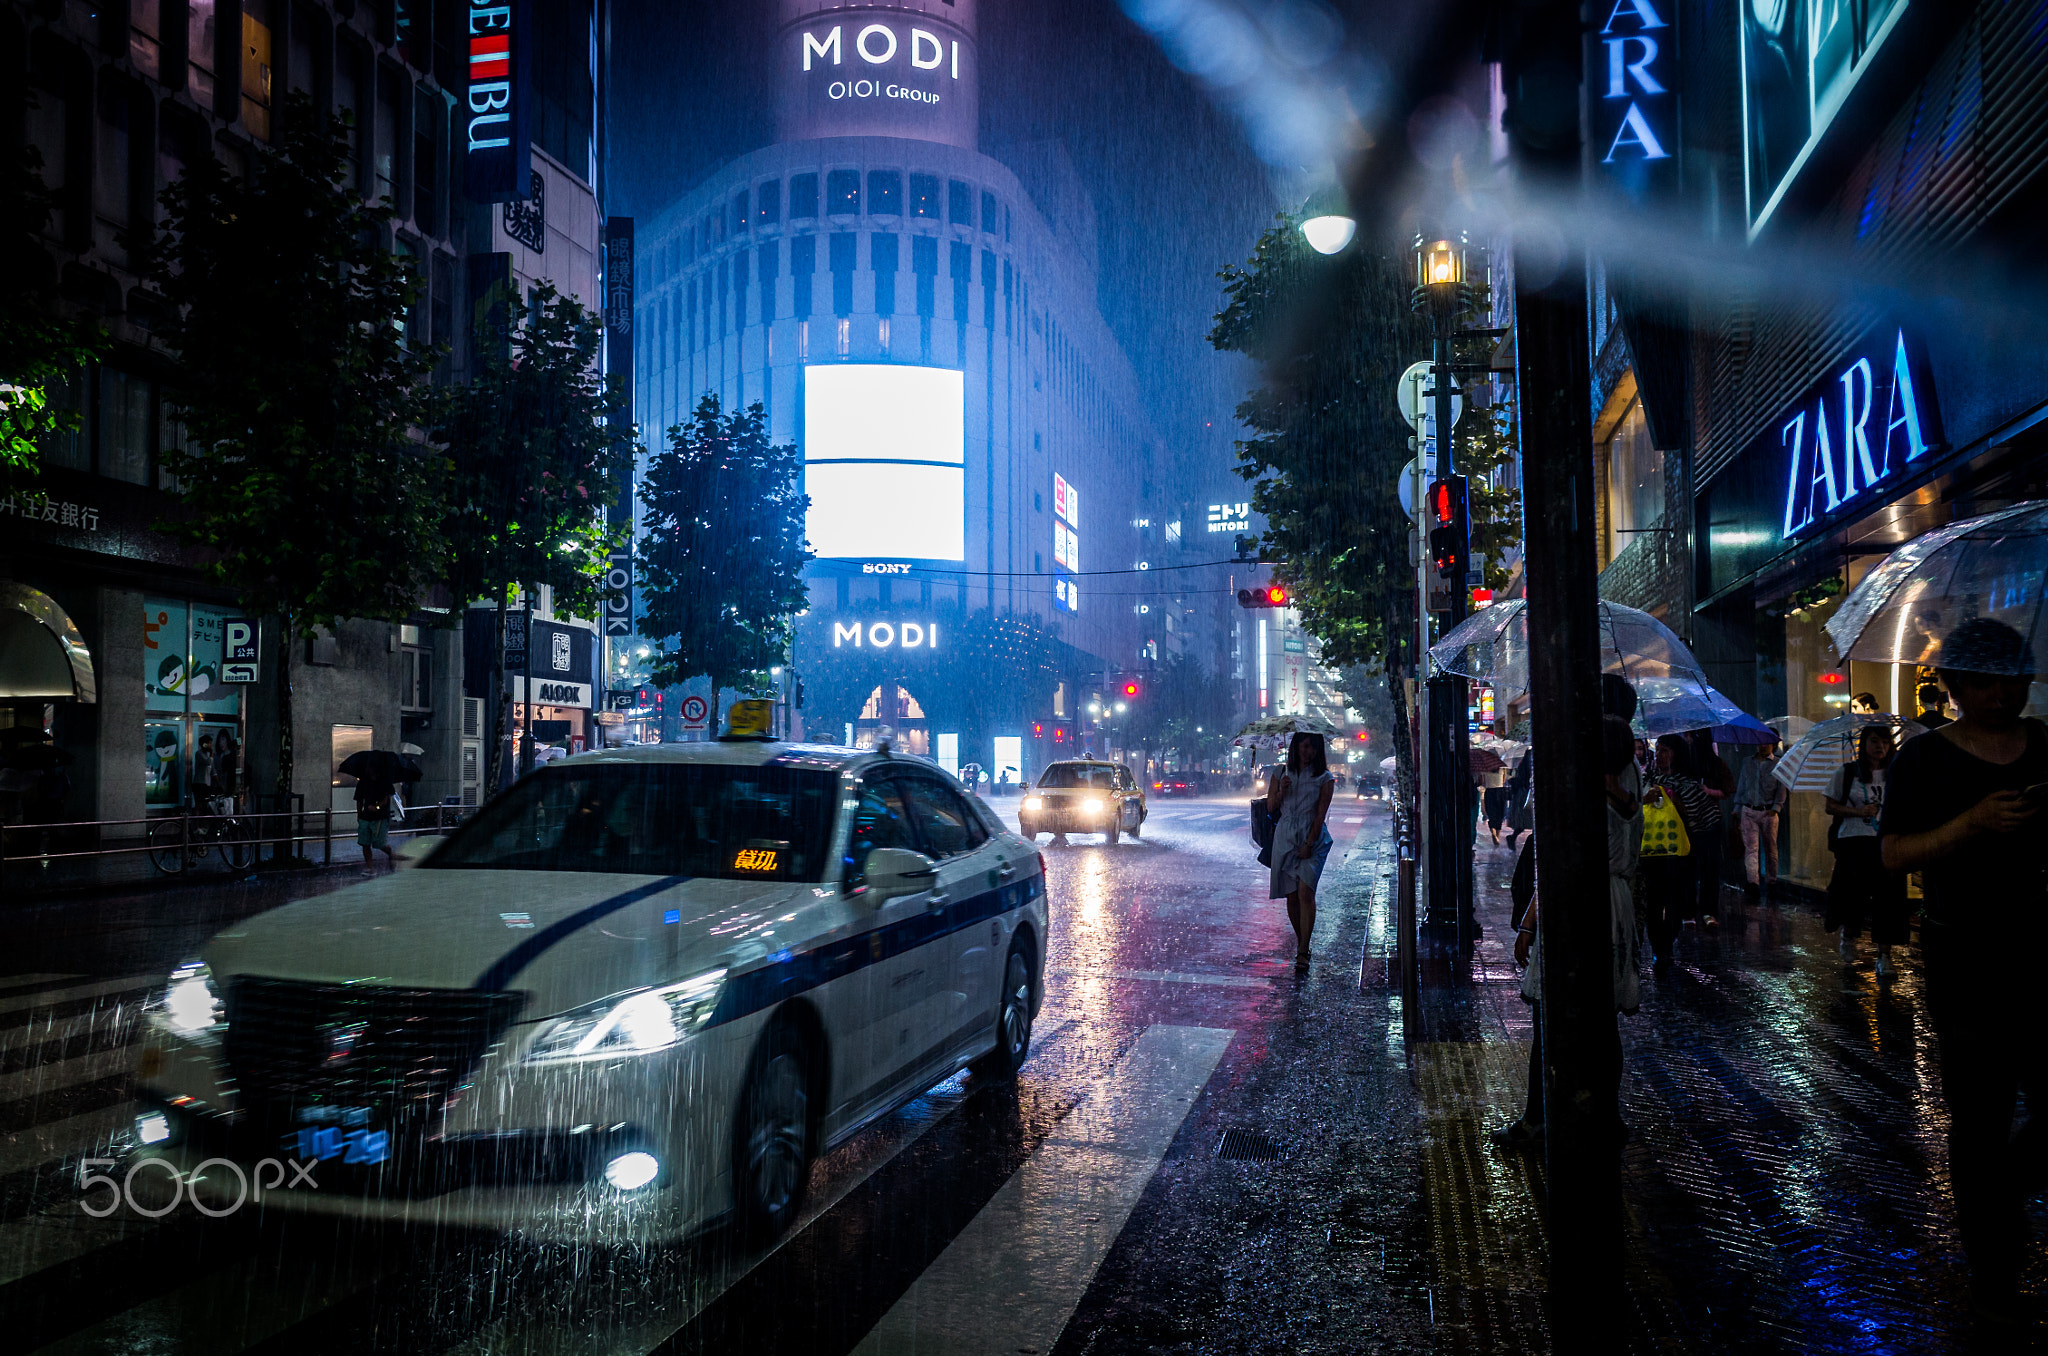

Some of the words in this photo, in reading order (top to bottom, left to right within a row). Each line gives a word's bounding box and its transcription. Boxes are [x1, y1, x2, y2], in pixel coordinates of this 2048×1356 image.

[803, 23, 958, 80] MODI
[468, 0, 511, 155] EIBU
[885, 84, 940, 104] GROUP
[609, 237, 632, 335] 眼鏡市場
[1782, 325, 1929, 540] ZARA
[1208, 503, 1249, 521] ニトリ
[1208, 521, 1249, 533] NITORI
[862, 563, 912, 574] SONY
[226, 622, 251, 658] P
[834, 622, 937, 648] MODI
[236, 647, 255, 658] 公共
